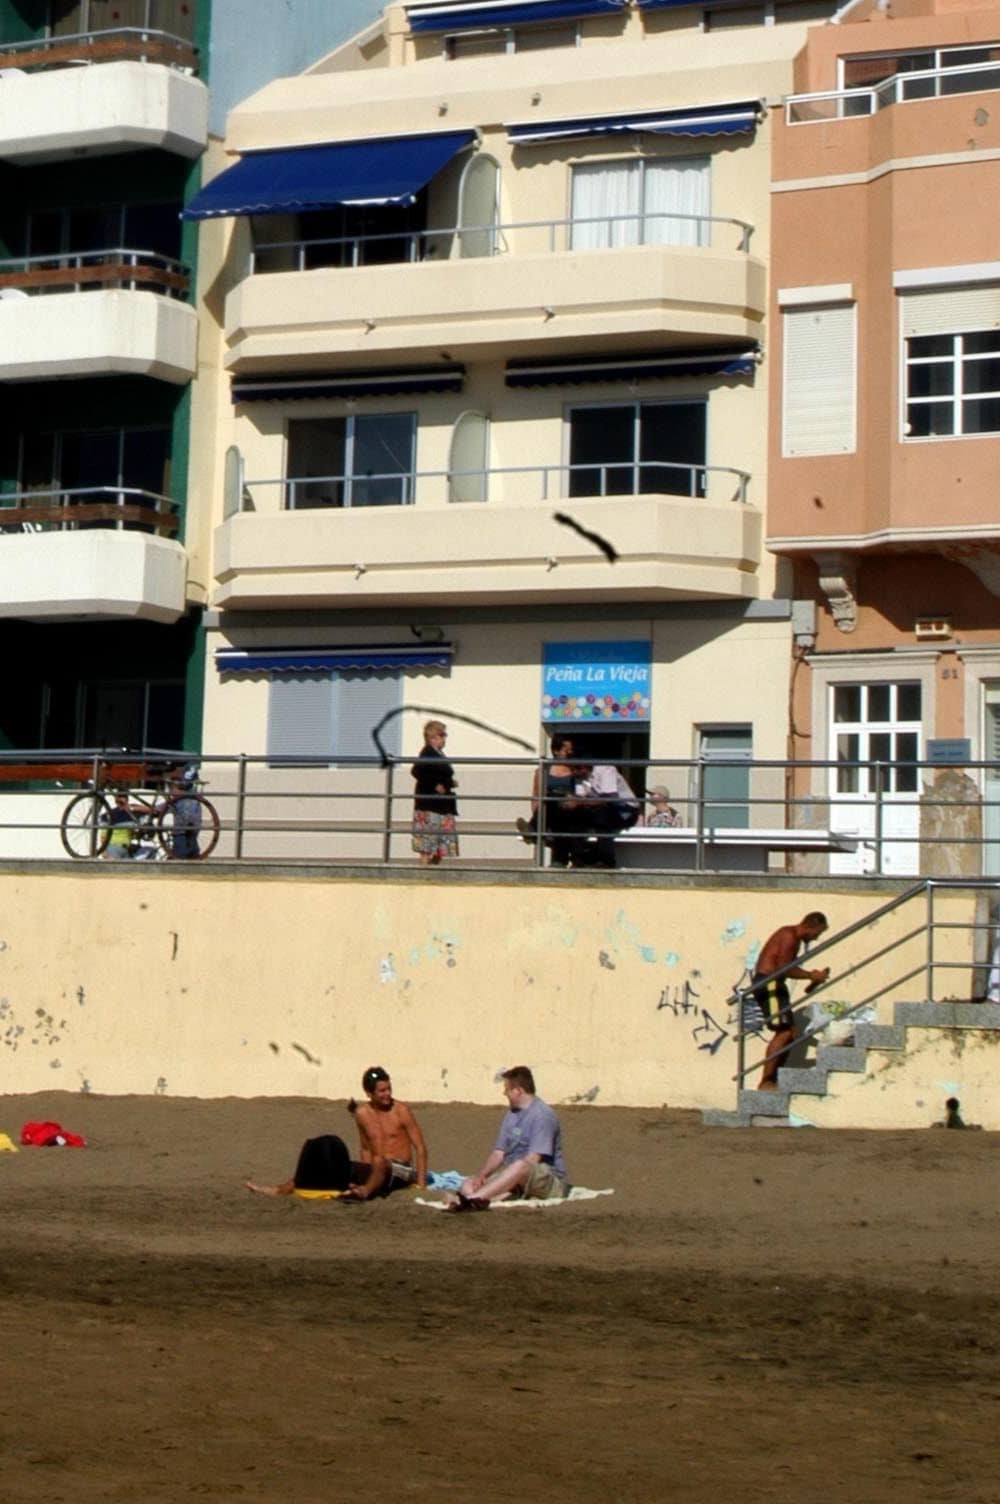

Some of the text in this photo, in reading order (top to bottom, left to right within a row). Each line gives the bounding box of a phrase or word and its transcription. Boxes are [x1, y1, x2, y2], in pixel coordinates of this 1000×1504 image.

[546, 665, 648, 684] Peña La Vieja
